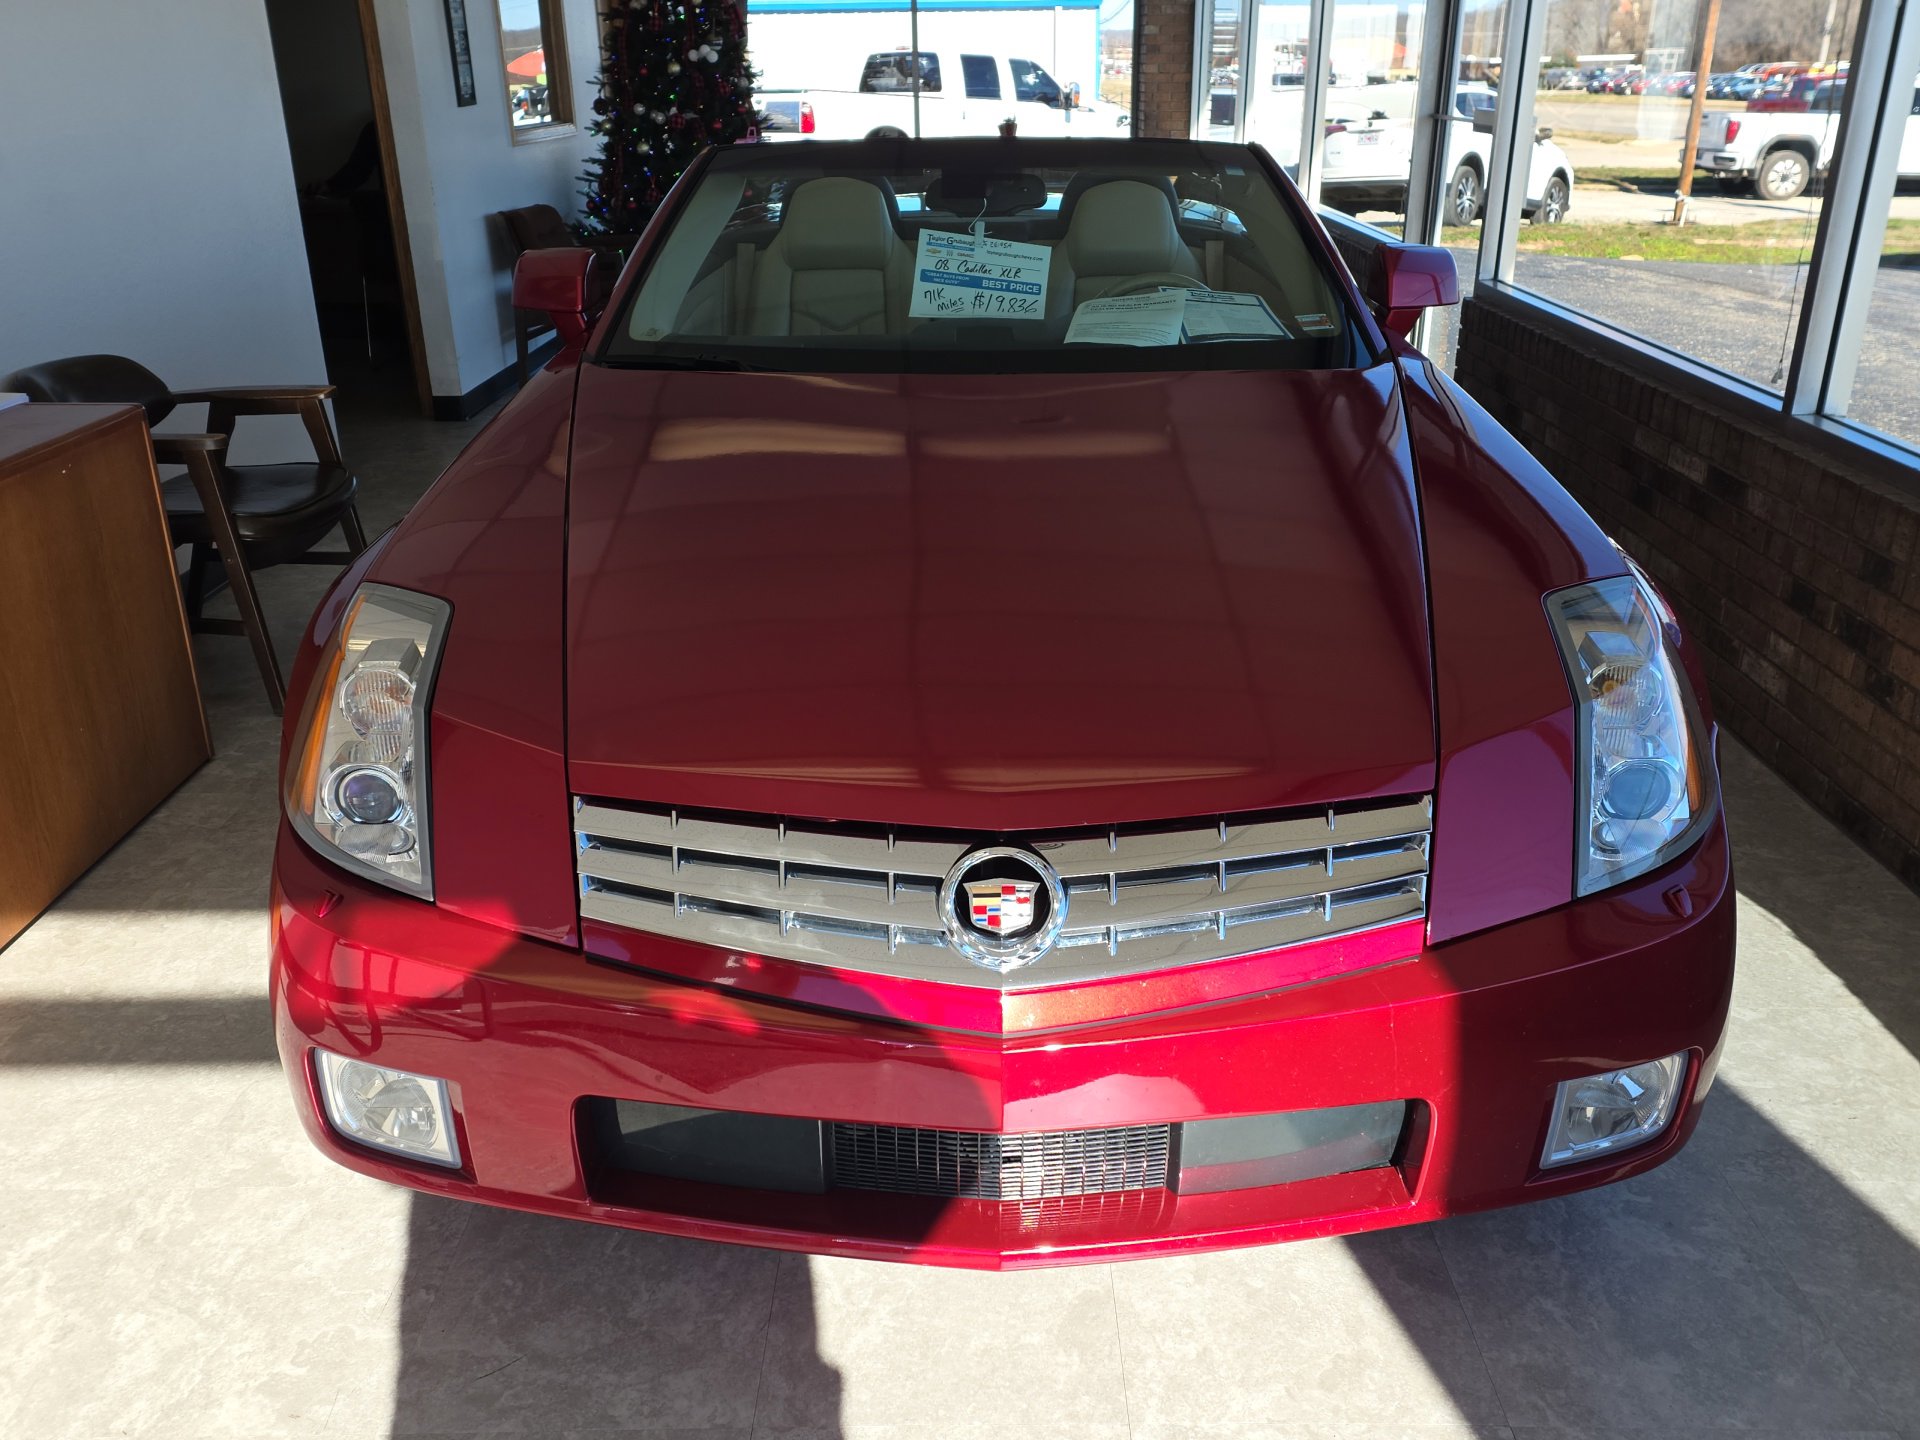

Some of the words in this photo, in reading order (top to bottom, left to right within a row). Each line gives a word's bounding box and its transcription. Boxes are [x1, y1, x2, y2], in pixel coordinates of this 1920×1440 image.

[934, 259, 950, 271] 08
[957, 259, 993, 275] Cadillac
[999, 267, 1022, 279] XLR
[982, 279, 1007, 289] BEST
[1010, 282, 1040, 293] PRICE
[924, 287, 946, 304] 71K
